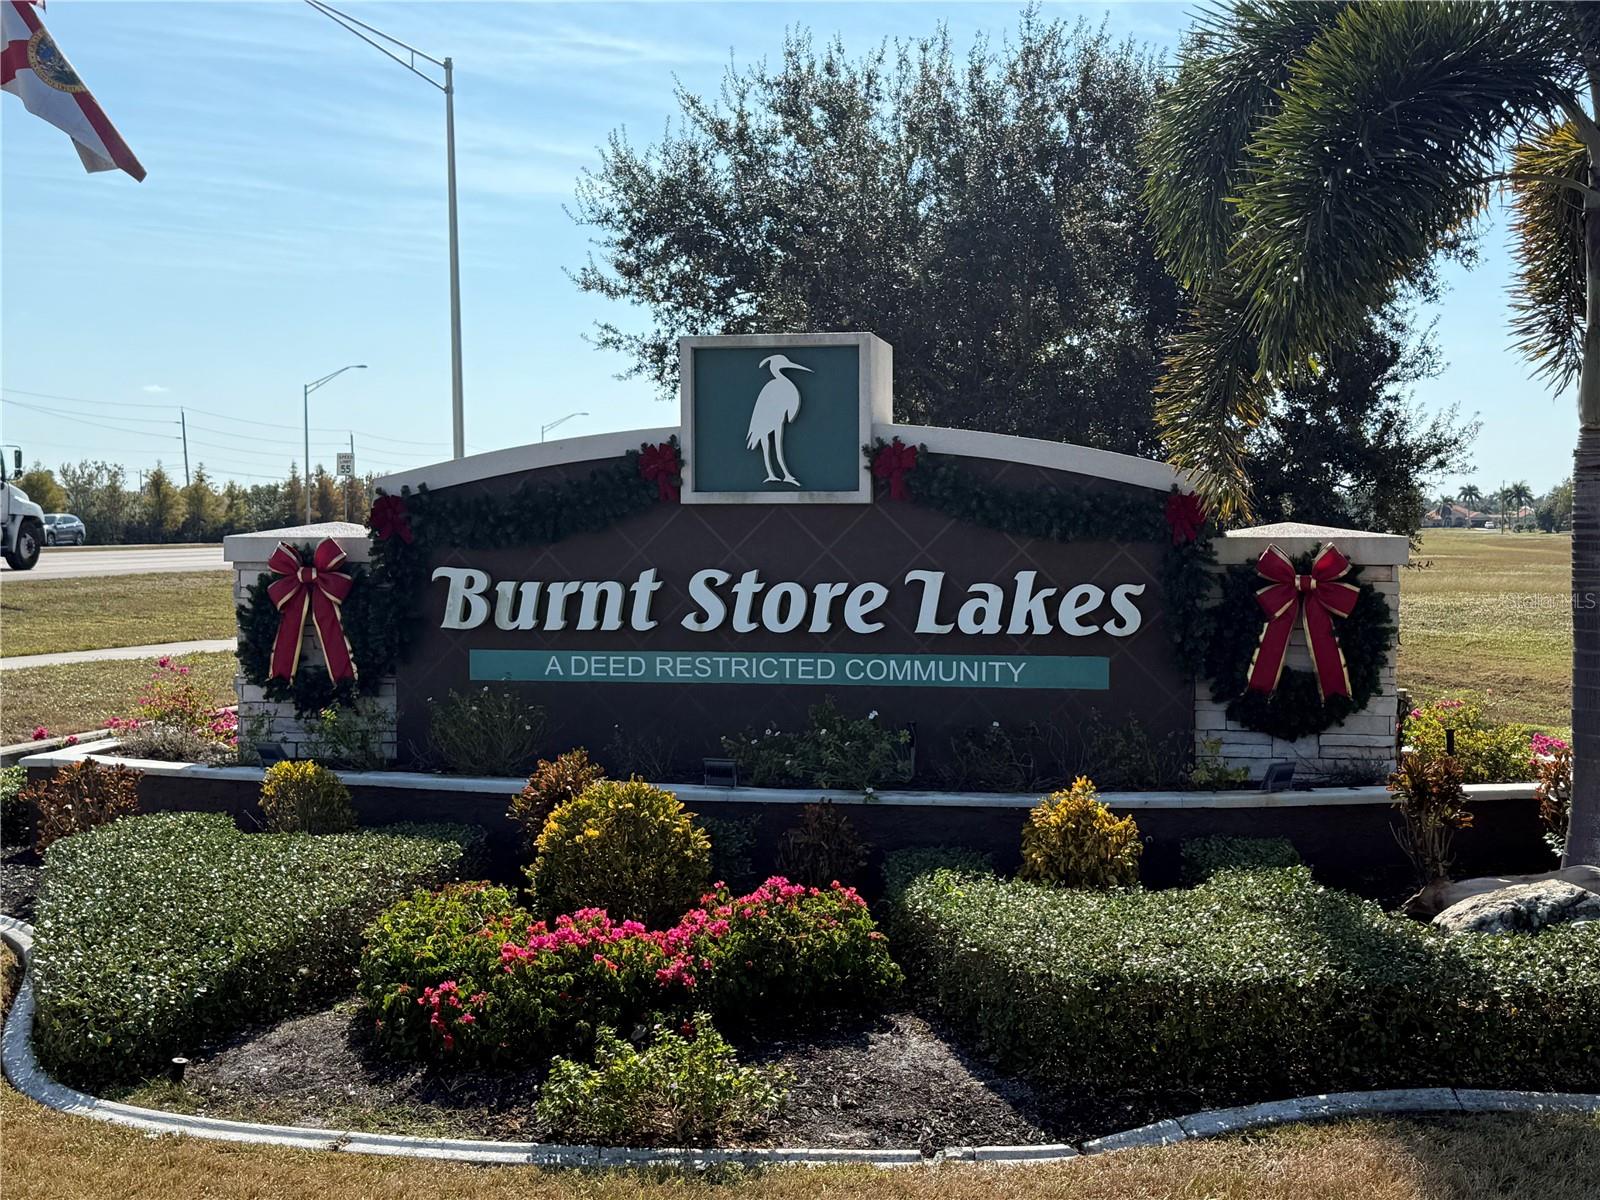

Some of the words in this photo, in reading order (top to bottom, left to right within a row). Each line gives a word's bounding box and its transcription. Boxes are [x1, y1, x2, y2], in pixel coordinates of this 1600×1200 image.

[341, 465, 351, 473] 55
[431, 566, 664, 632] Burnt
[680, 568, 890, 634] Store
[904, 569, 1146, 637] Lakes
[544, 656, 565, 676] A
[571, 656, 646, 677] DEED
[655, 657, 836, 680] RESTRICTED
[845, 659, 1027, 683] COMMUNITY
